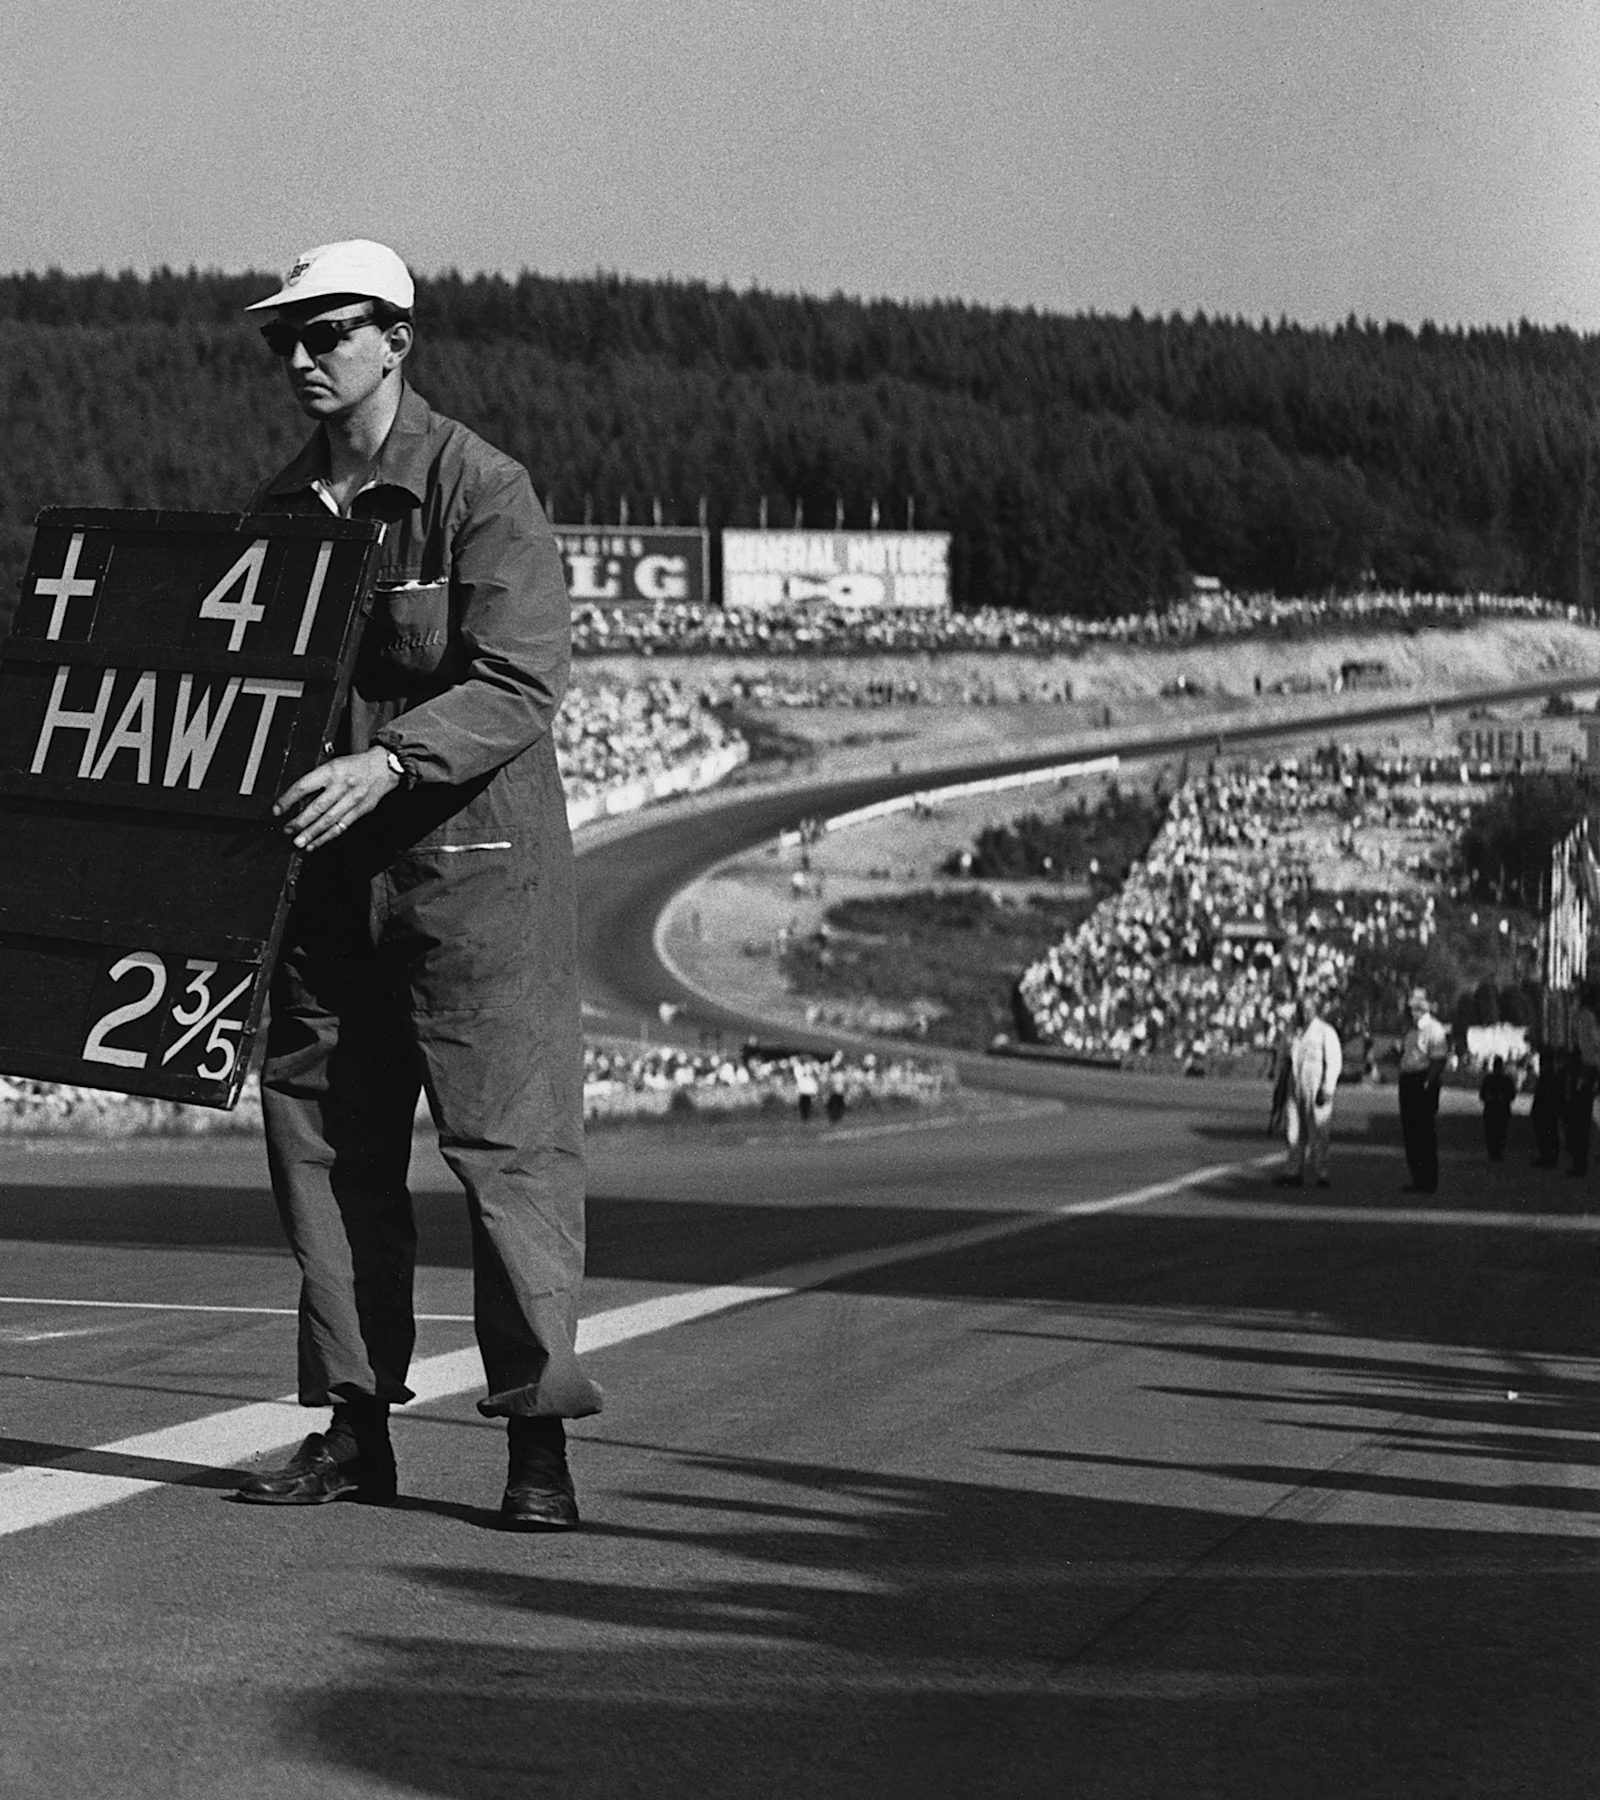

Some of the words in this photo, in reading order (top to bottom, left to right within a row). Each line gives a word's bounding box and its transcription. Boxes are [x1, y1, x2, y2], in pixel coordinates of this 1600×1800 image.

[34, 533, 96, 641] +
[199, 539, 333, 655] 41
[724, 534, 840, 573] GENERAL
[847, 536, 950, 574] MOTORS
[30, 665, 304, 795] HAWT
[1457, 730, 1544, 760] SHELL
